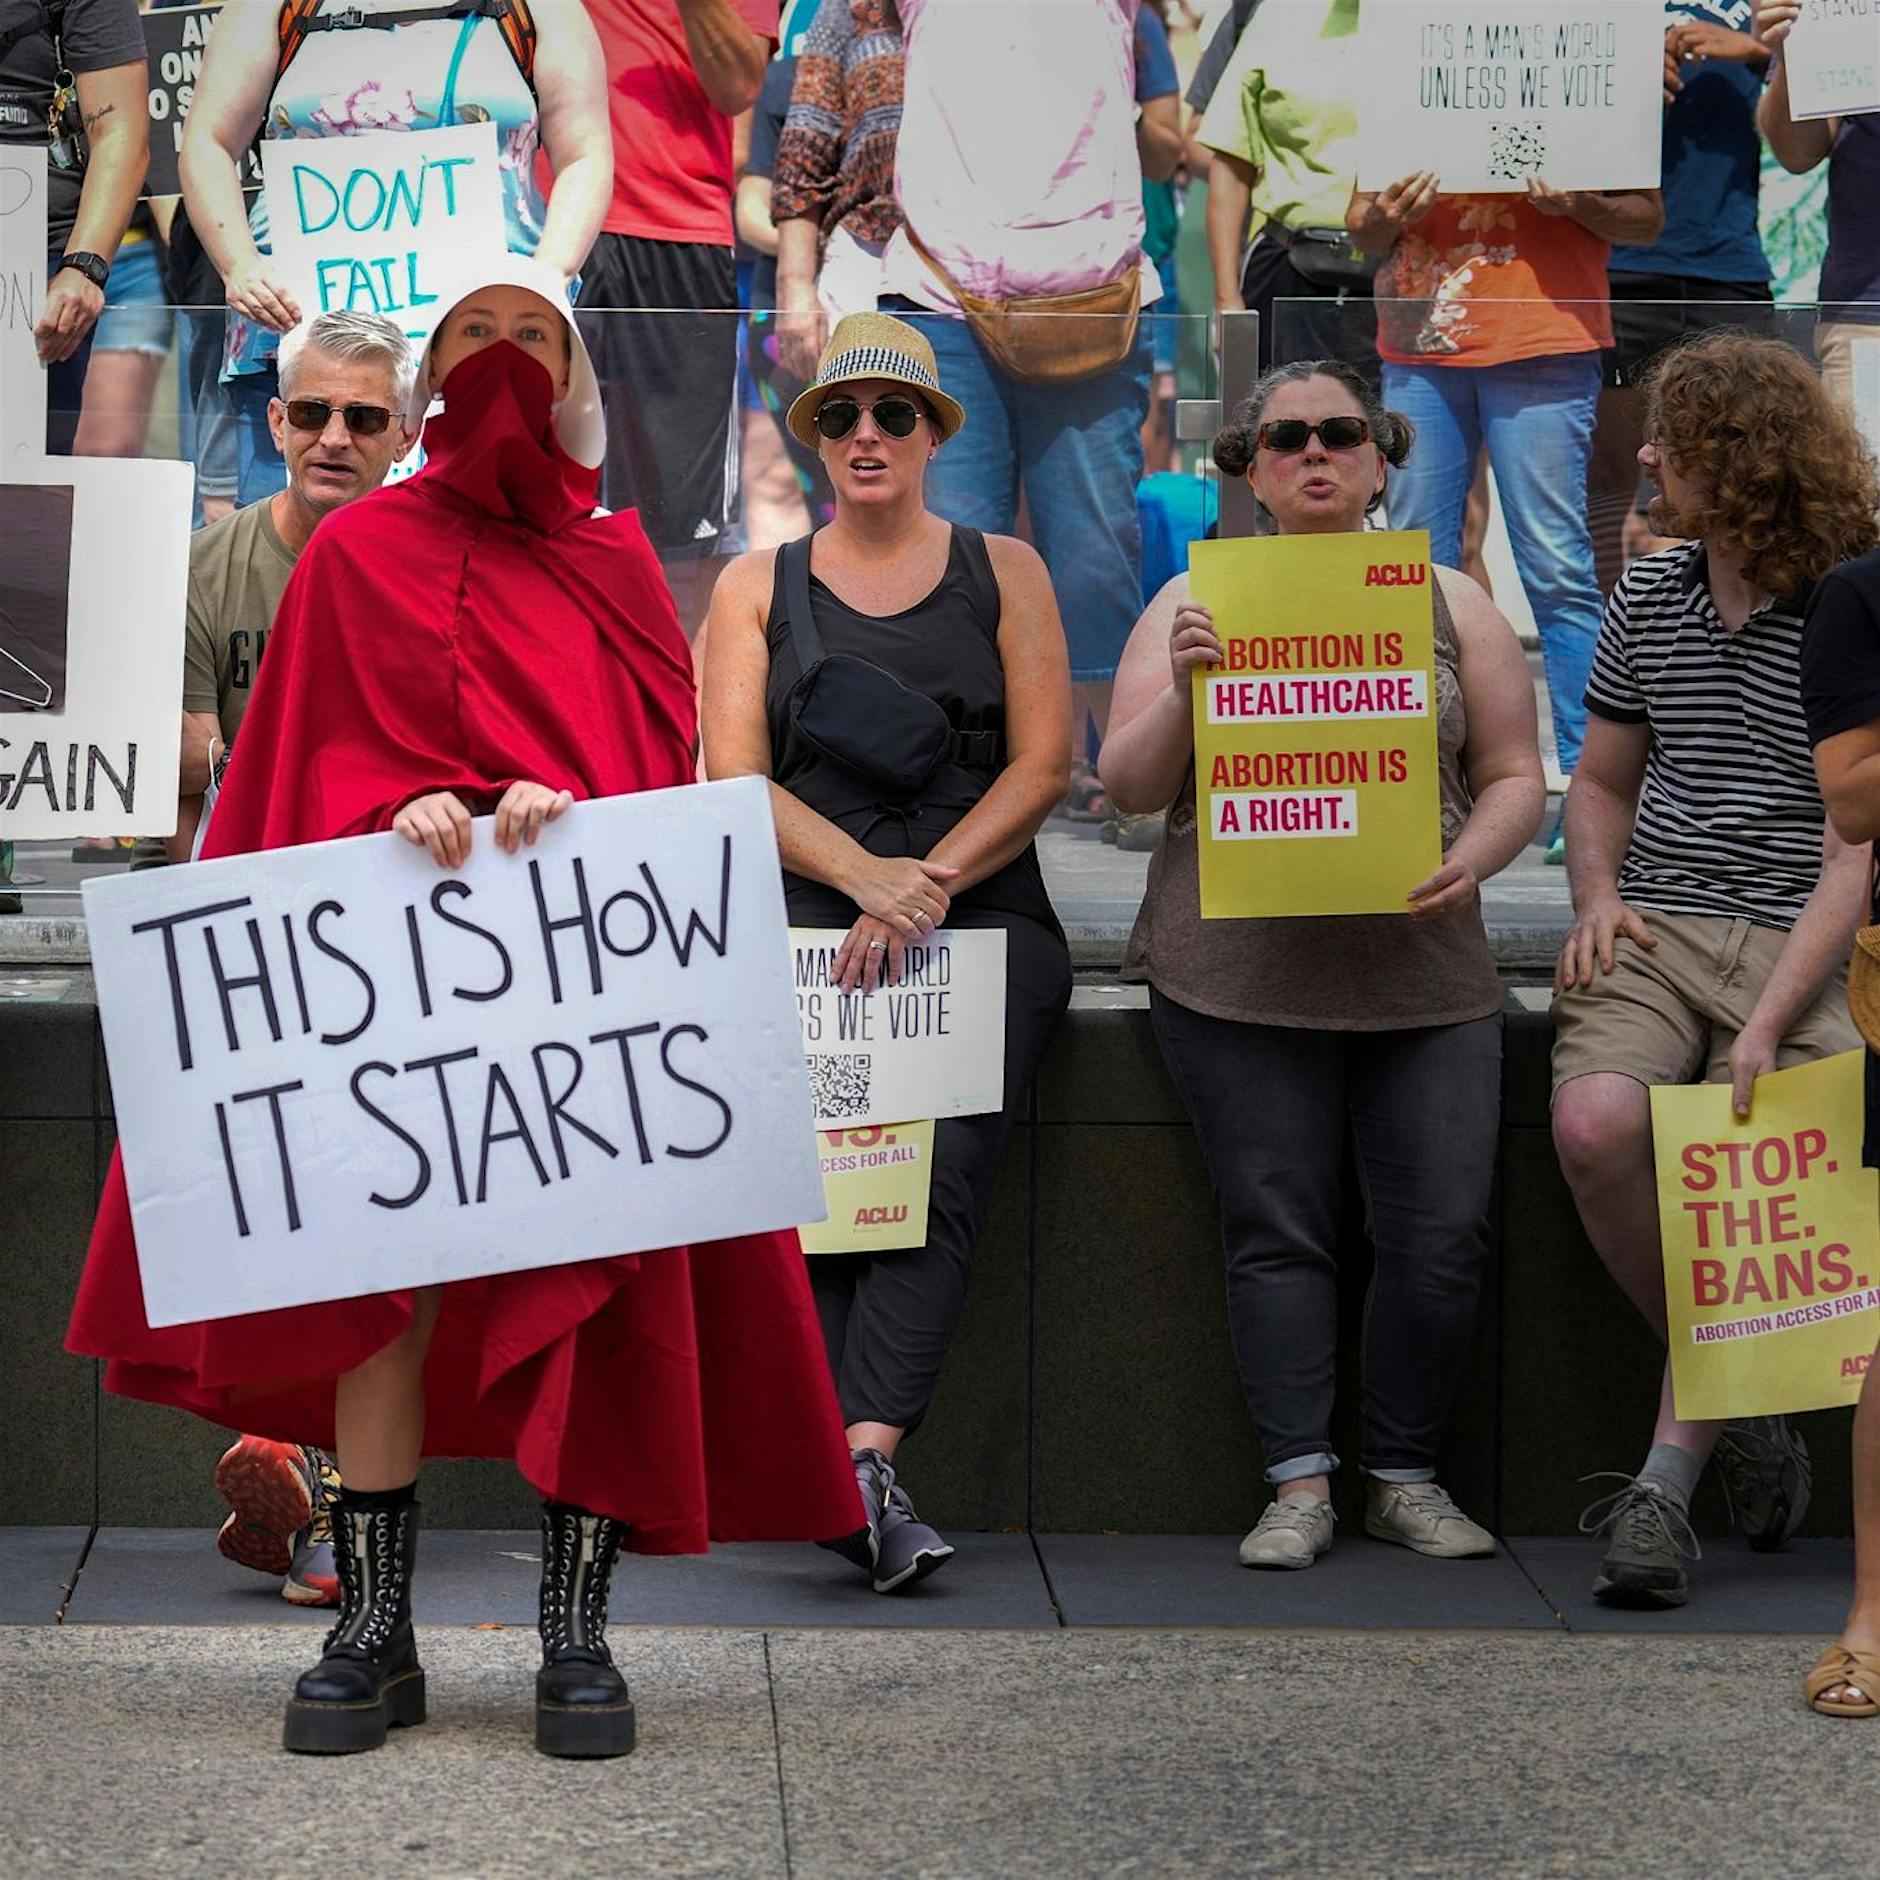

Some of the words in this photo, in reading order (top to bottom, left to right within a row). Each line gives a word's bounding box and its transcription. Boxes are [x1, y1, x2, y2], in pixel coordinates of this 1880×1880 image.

[1464, 24, 1474, 60] A
[1485, 24, 1544, 60] MAN'S
[1555, 22, 1616, 59] WORLD
[1420, 65, 1507, 109] UNLESS
[1519, 65, 1550, 108] WE
[1563, 64, 1615, 107] VOTE
[316, 251, 439, 312] FAIL
[1365, 563, 1425, 587] ACLU
[1375, 632, 1403, 666] IS
[1216, 677, 1424, 717] HEALTHCARE.
[1210, 750, 1369, 788] ABORTION
[1379, 749, 1408, 782] IS
[1220, 800, 1240, 833] A
[1250, 797, 1351, 832] RIGHT.
[132, 896, 376, 1071] THIS
[404, 880, 513, 1018] IS
[837, 993, 874, 1041] WE
[888, 991, 951, 1040] VOTE
[214, 1080, 303, 1238] IT
[349, 1021, 733, 1210] STARTS
[861, 1151, 887, 1168] FOR
[892, 1146, 916, 1163] ALL
[1681, 1128, 1838, 1192] STOP.
[854, 1205, 908, 1225] ACLU
[1683, 1193, 1816, 1249] THE.
[1691, 1243, 1869, 1306] BANS.
[1695, 1317, 1772, 1342] ABORTION
[1776, 1302, 1832, 1330] ACCESS
[1835, 1294, 1864, 1315] FOR
